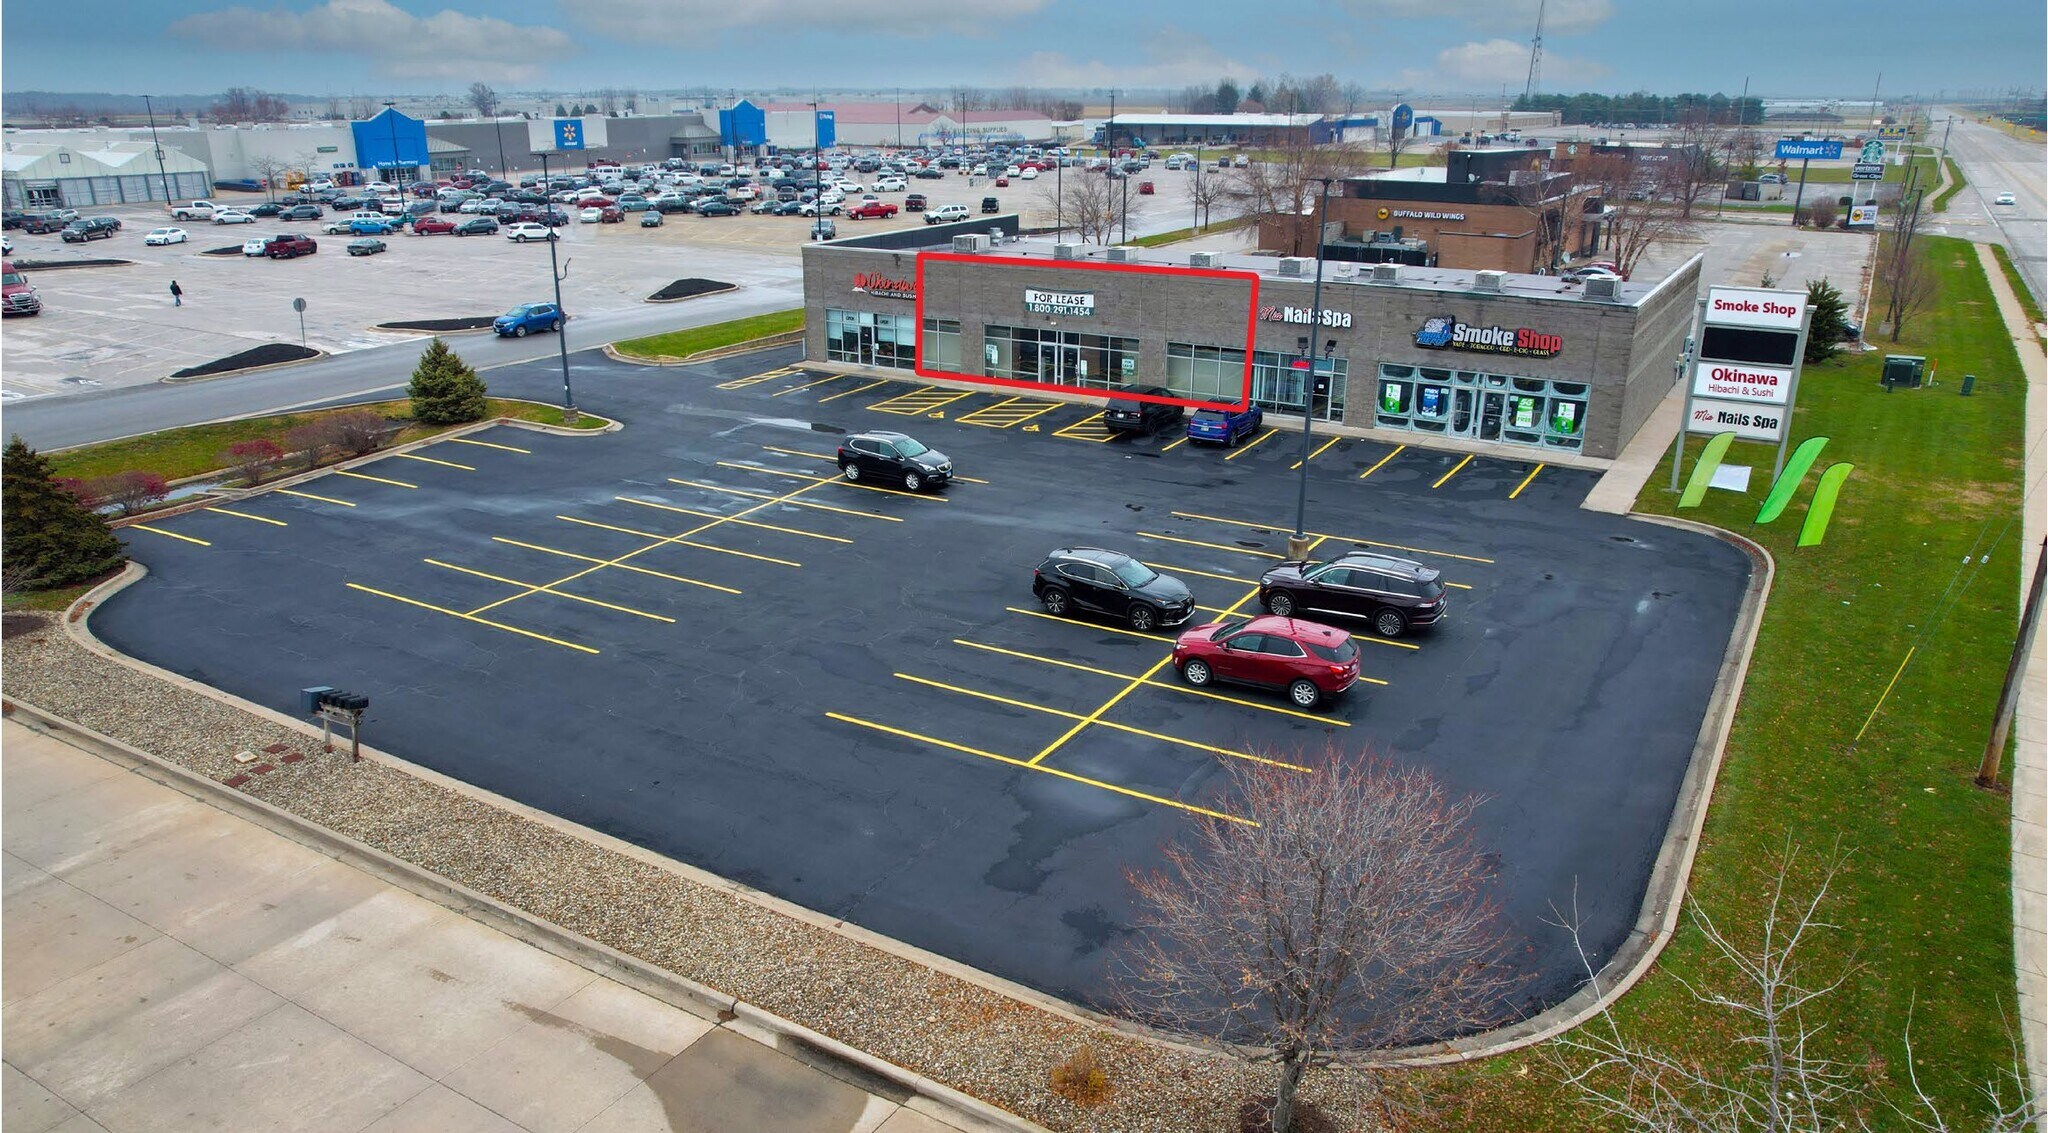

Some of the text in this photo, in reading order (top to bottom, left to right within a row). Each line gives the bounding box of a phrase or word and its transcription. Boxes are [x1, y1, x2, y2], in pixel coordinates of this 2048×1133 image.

[1781, 144, 1823, 155] Walmart
[1640, 154, 1669, 162] verizon
[1393, 209, 1465, 220] BUFFALO WILD WINGS
[1034, 293, 1085, 305] FOR LEASE
[1029, 303, 1090, 316] 1.800.291.1454
[1714, 299, 1797, 318] Smoke Shop
[1322, 309, 1352, 328] Spa
[1453, 323, 1562, 353] Smoke Shop
[1533, 348, 1550, 356] GLASS
[1711, 368, 1778, 386] Okinawa
[1708, 384, 1774, 397] Hibachi & Sushi
[1520, 397, 1533, 406] 5G
[1694, 409, 1778, 429] Mia Nails Spa
